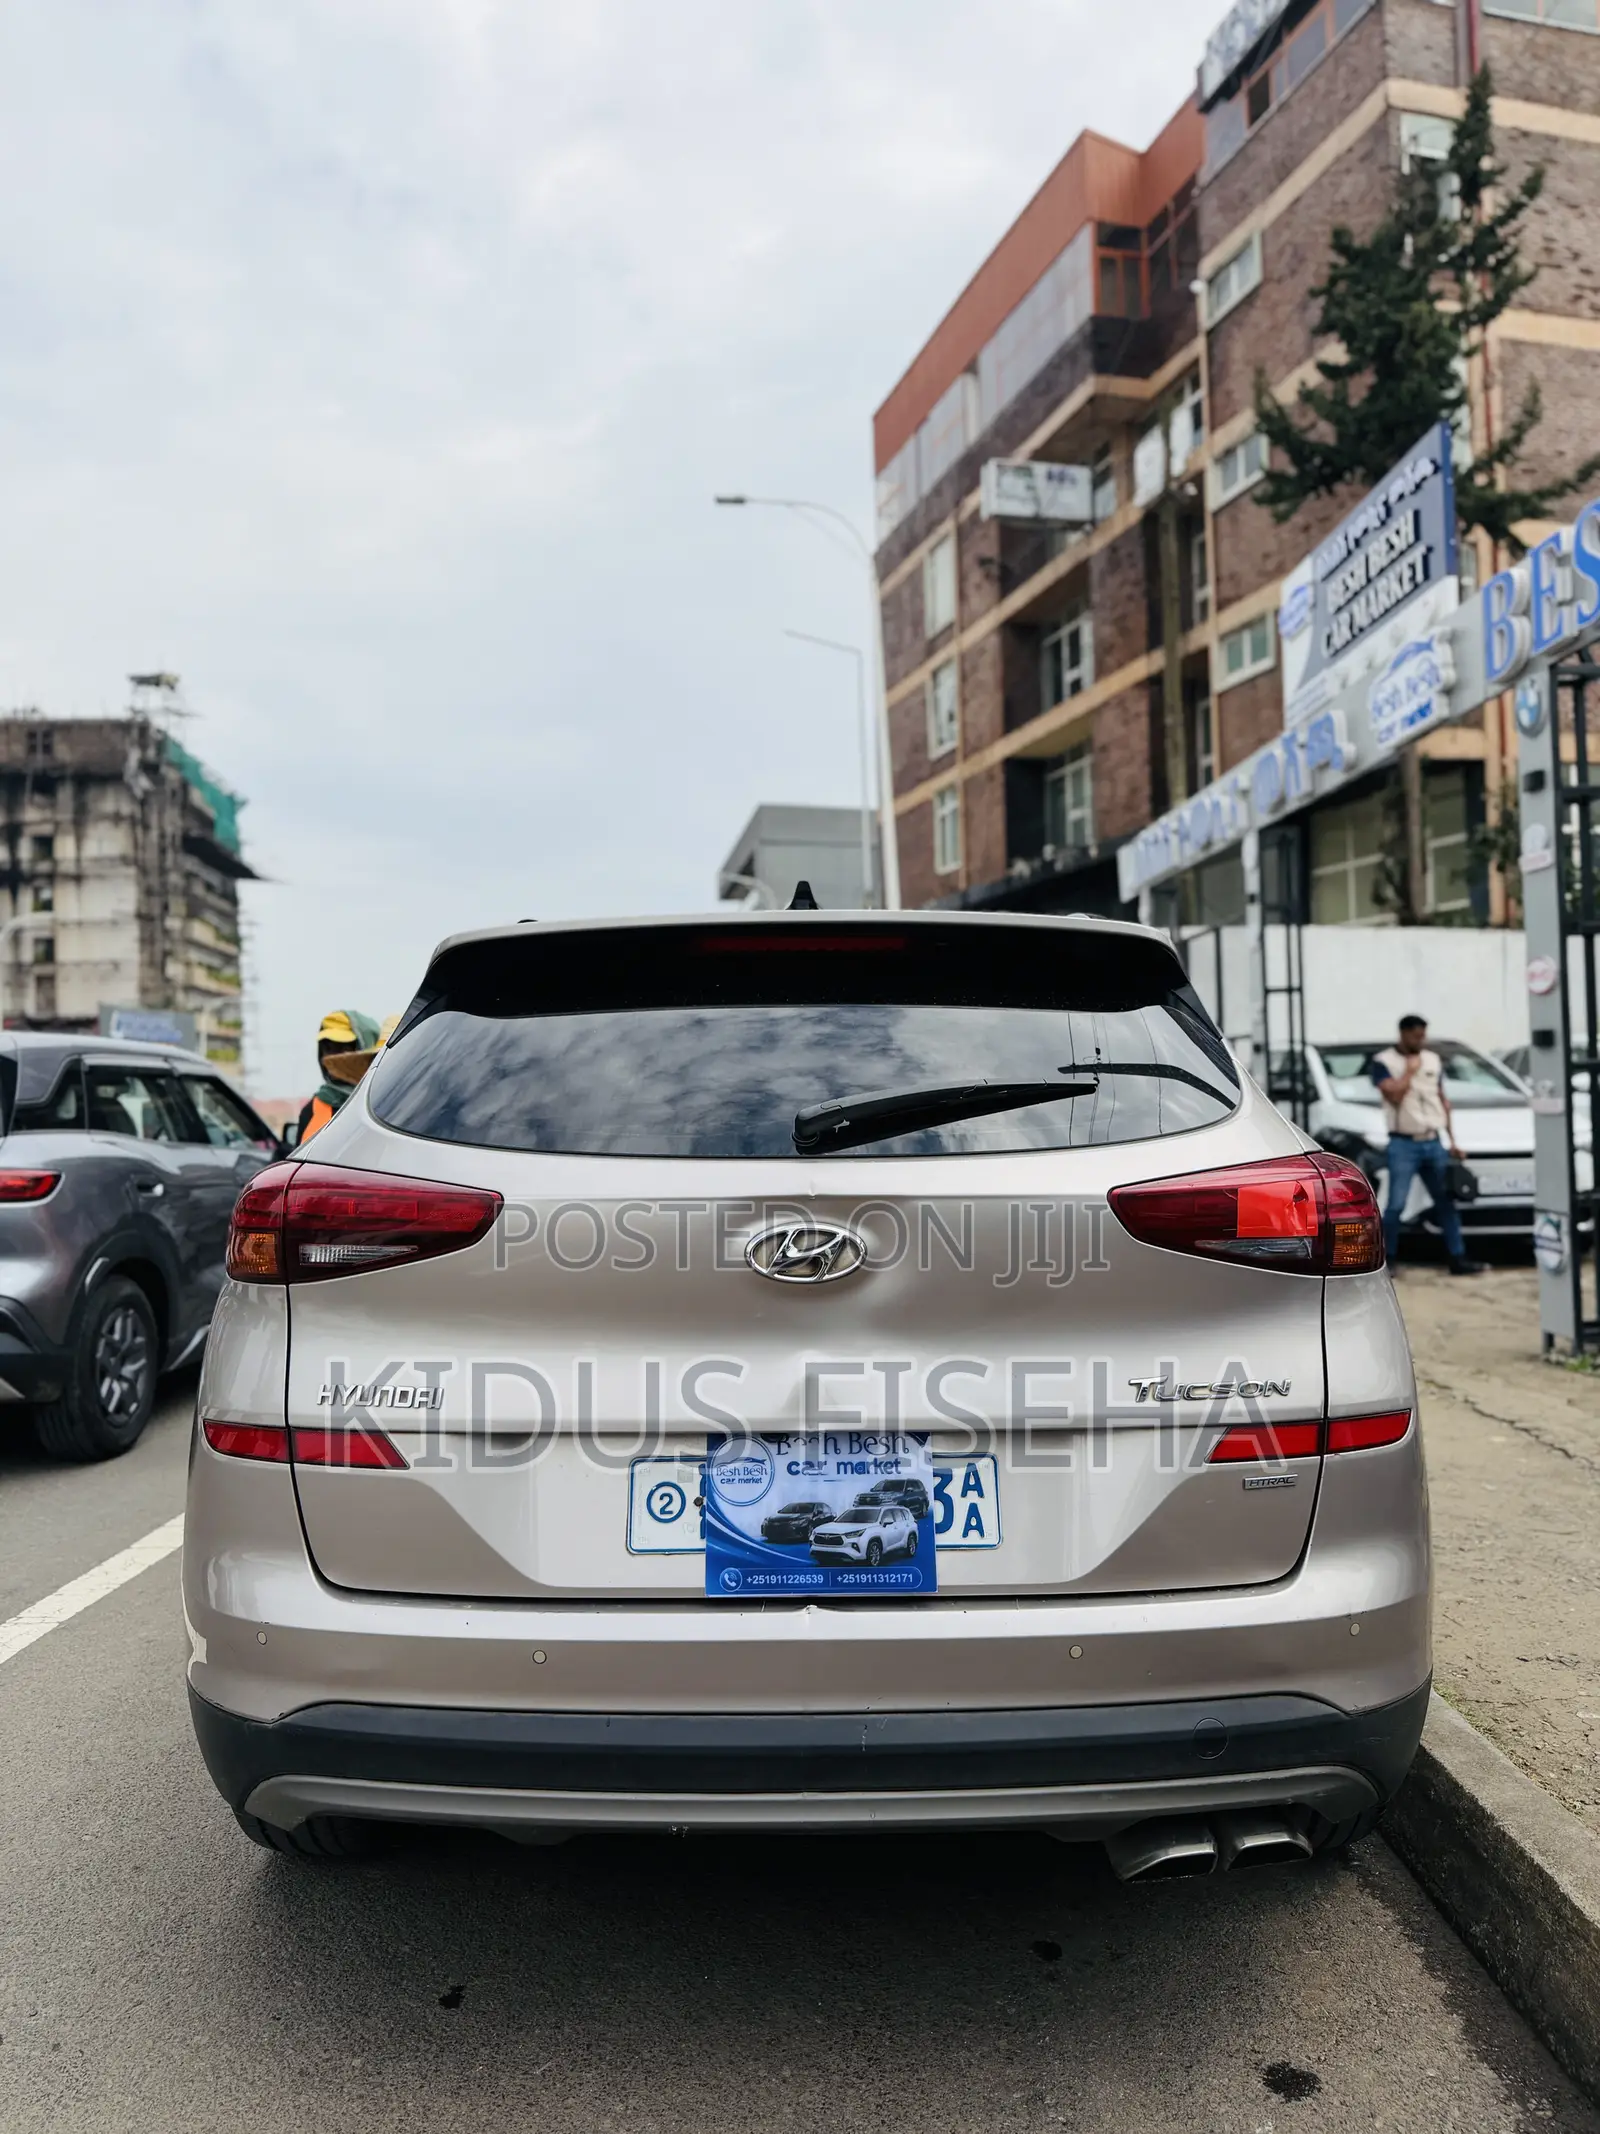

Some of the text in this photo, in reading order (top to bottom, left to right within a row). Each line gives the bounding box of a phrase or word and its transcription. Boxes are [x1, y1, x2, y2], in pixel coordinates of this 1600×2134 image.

[316, 1383, 444, 1410] HYUNDAI
[848, 1431, 909, 1456] Besh
[743, 1464, 768, 1476] Besh
[836, 1457, 901, 1475] market
[746, 1573, 913, 1584] +251911226539 +251911312171
